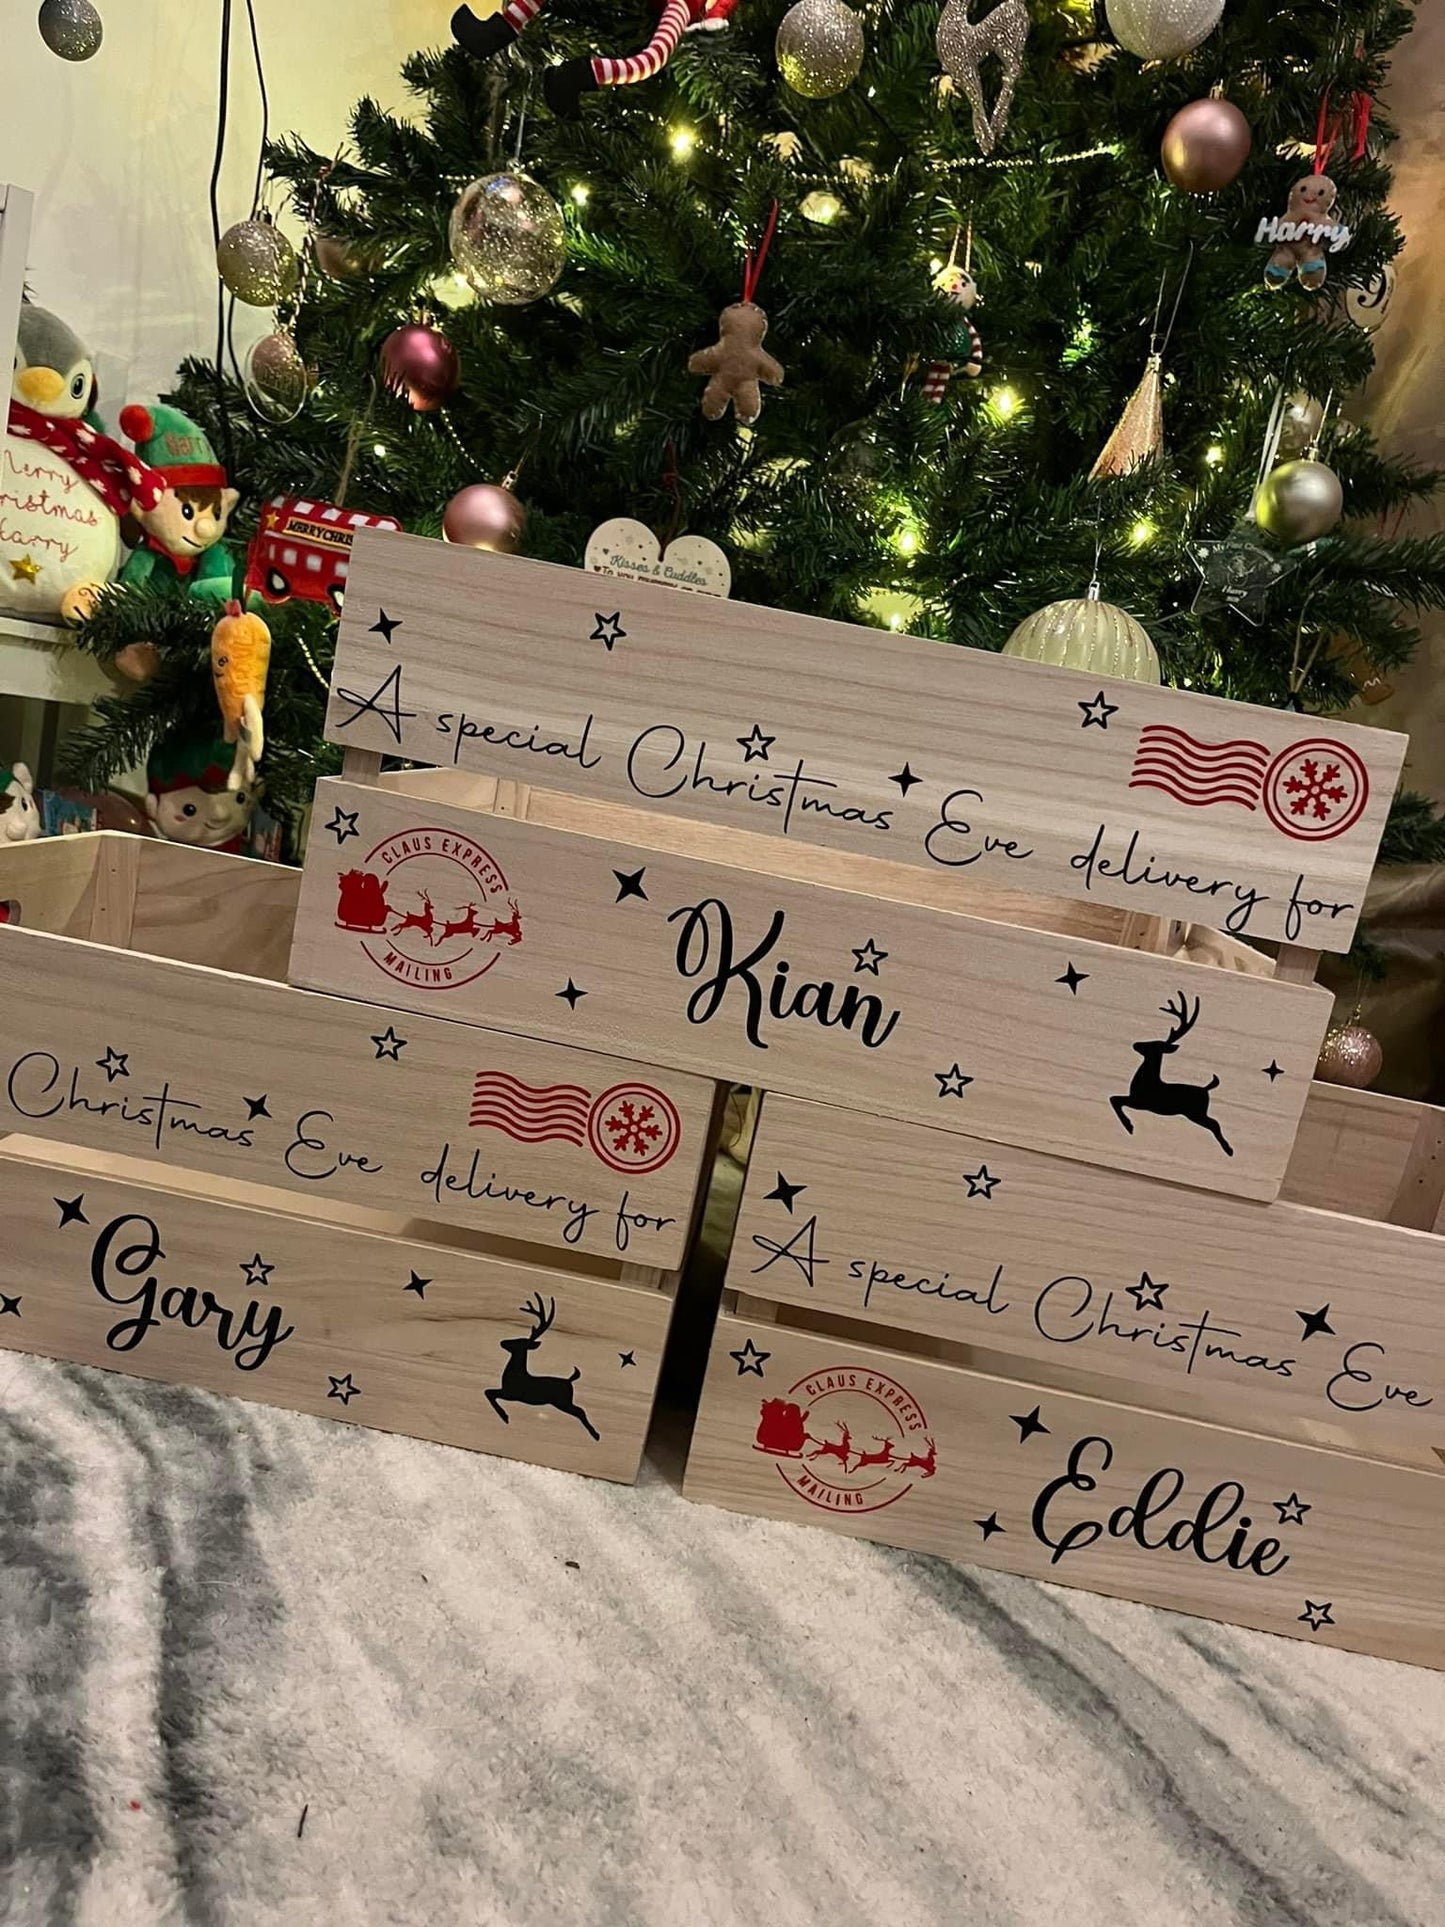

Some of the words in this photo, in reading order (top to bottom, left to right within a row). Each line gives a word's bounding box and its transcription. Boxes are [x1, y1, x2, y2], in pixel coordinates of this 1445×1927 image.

[1254, 216, 1352, 253] Harry
[288, 520, 322, 539] MERRY
[610, 555, 650, 573] Kisses
[652, 565, 660, 576] &
[664, 566, 708, 586] Cuddles
[335, 664, 417, 744] A
[436, 713, 601, 768] special
[627, 724, 894, 834] Christmas
[924, 789, 1034, 866] Eve
[1070, 823, 1270, 931] delivery
[1285, 874, 1355, 941] for
[381, 836, 432, 865] CLAUS
[442, 838, 503, 894] EXPRESS
[383, 951, 453, 983] MAILING
[667, 898, 901, 1049] Kian
[8, 1052, 254, 1150] Christmas
[285, 1110, 383, 1179] Eve
[420, 1143, 599, 1243] delivery
[615, 1191, 676, 1251] for
[91, 1214, 295, 1371] Gary
[750, 1215, 830, 1287] A
[848, 1260, 1009, 1314] special
[1034, 1276, 1297, 1377] Christmas
[1326, 1342, 1433, 1412] Eve
[806, 1374, 857, 1396] CLAUS
[866, 1377, 922, 1431] EXPRESS
[797, 1475, 864, 1506] MAILING
[1032, 1436, 1290, 1577] Eddie
